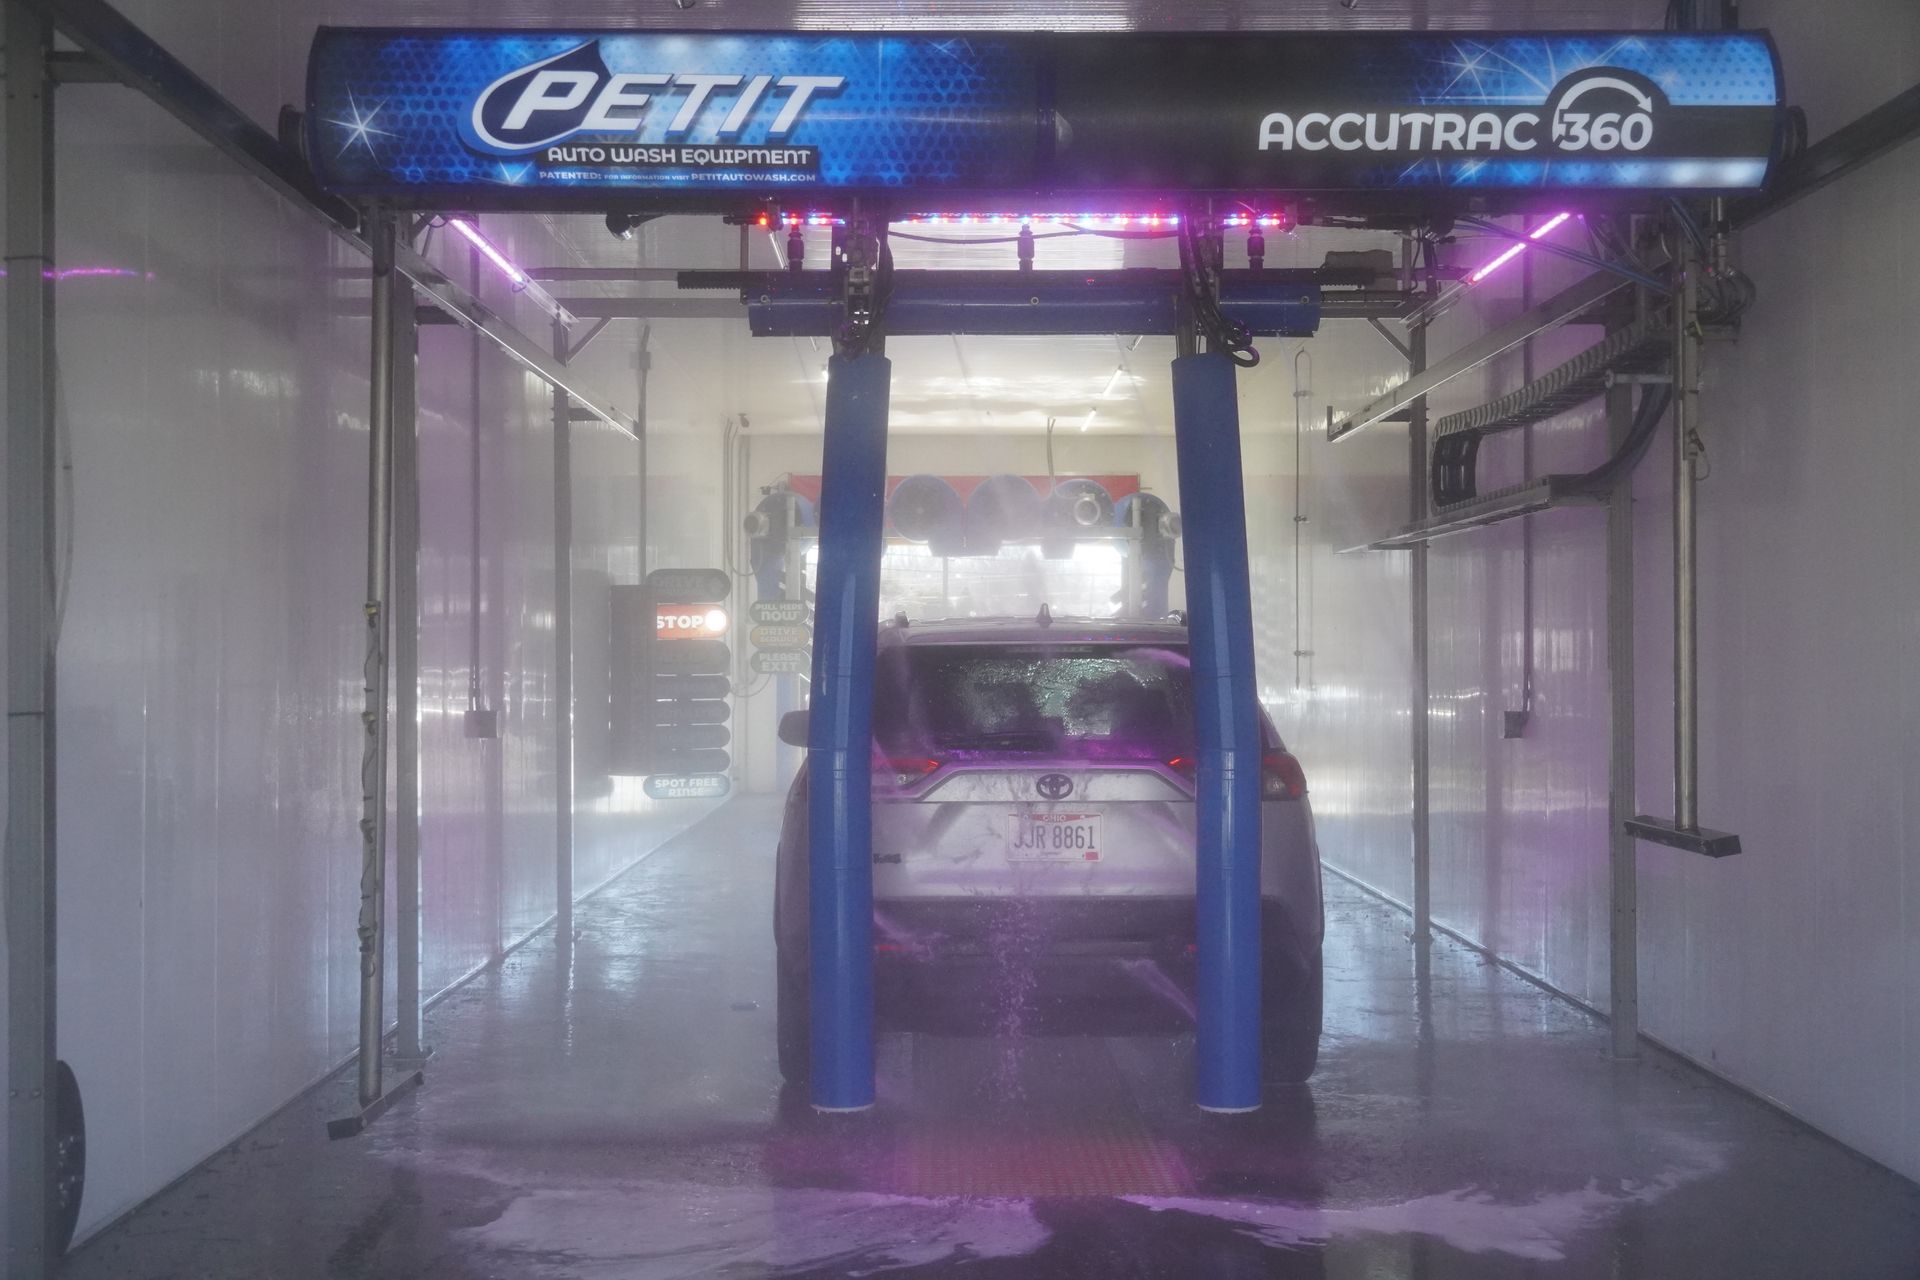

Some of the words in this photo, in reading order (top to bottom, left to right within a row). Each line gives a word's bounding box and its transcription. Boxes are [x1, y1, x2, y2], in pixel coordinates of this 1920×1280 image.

[501, 70, 846, 134] PETIT
[1258, 112, 1540, 151] ACCUTRAC
[1555, 112, 1653, 151] 360
[548, 147, 605, 163] AUTO
[611, 148, 676, 164] WASH
[682, 148, 811, 165] EQUIPMENT
[539, 171, 602, 180] PATENTED:
[691, 173, 816, 183] PETITAUTOWASH.COM
[657, 615, 703, 629] STOP
[762, 662, 798, 671] EXIT
[655, 779, 685, 788] SPOT
[689, 778, 718, 787] FREE
[1052, 825, 1095, 849] 8861
